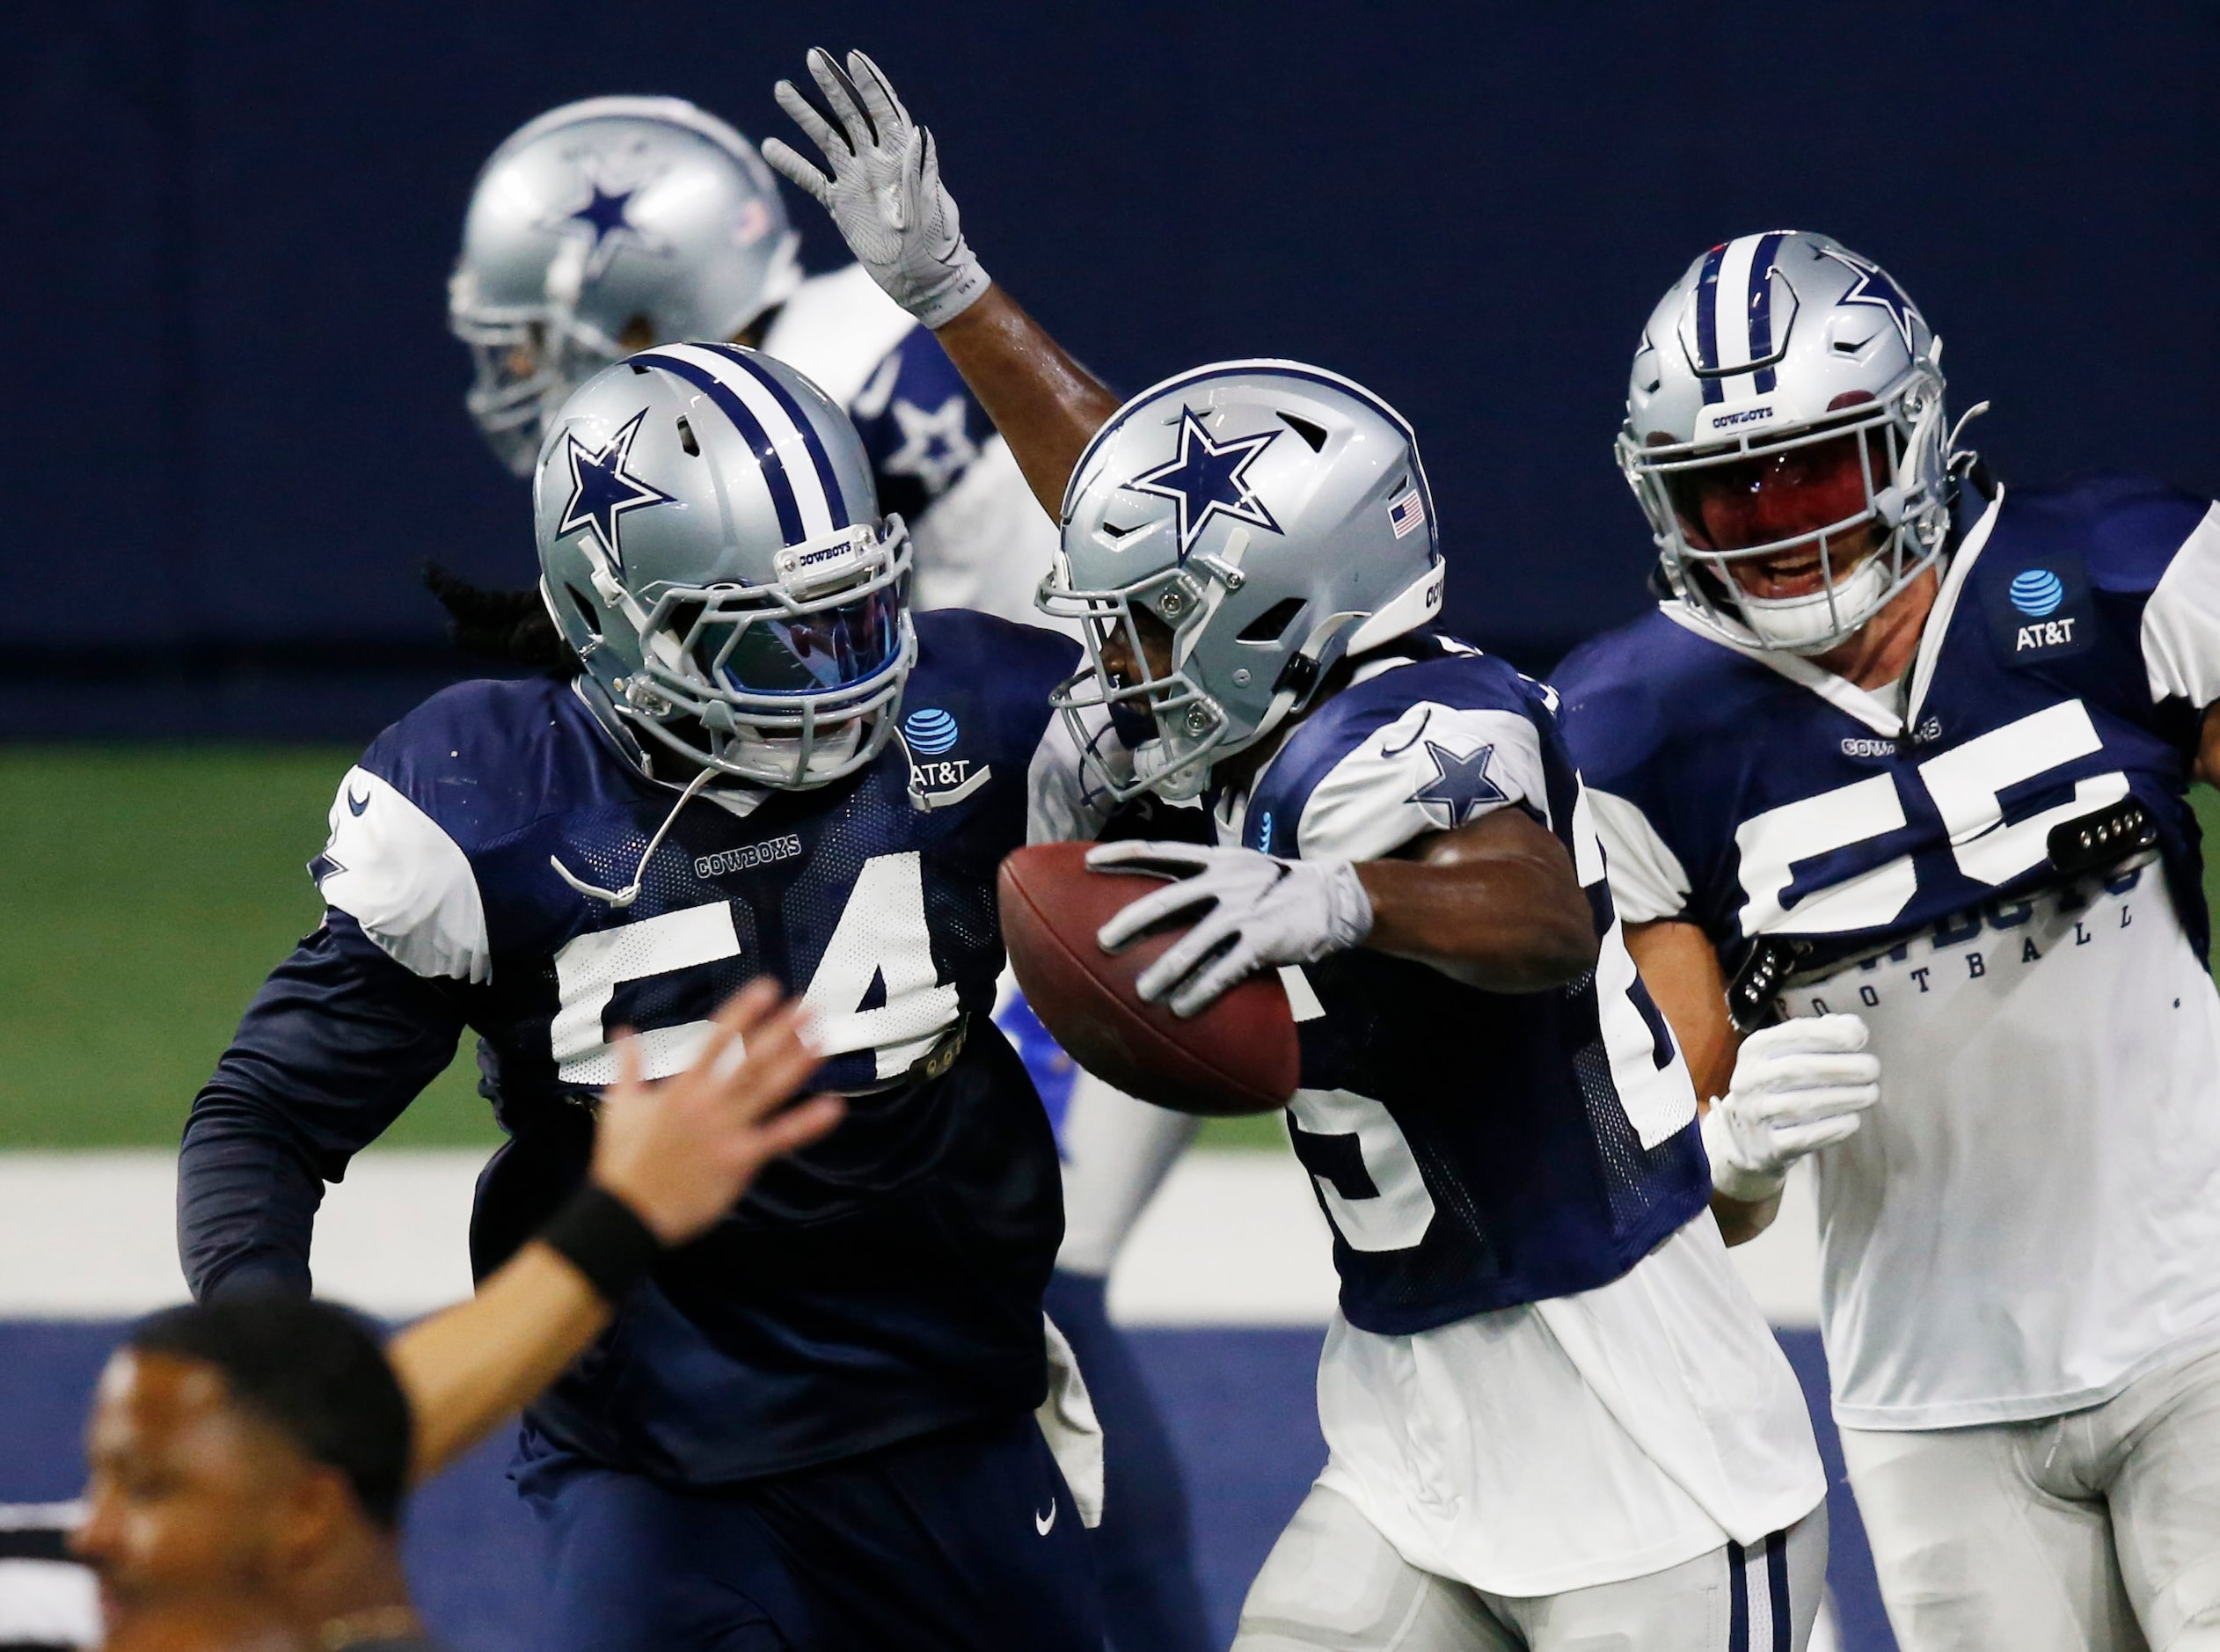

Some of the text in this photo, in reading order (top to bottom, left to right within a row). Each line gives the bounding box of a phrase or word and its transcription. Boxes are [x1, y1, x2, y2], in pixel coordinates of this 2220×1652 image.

[1712, 406, 1773, 428] COWBOYS
[800, 542, 851, 567] COWBOYS
[2017, 618, 2076, 651] AT&T
[909, 759, 970, 786] AT&T
[1734, 698, 2132, 939] 55
[694, 833, 802, 879] COWBOYS
[551, 850, 960, 1085] 54
